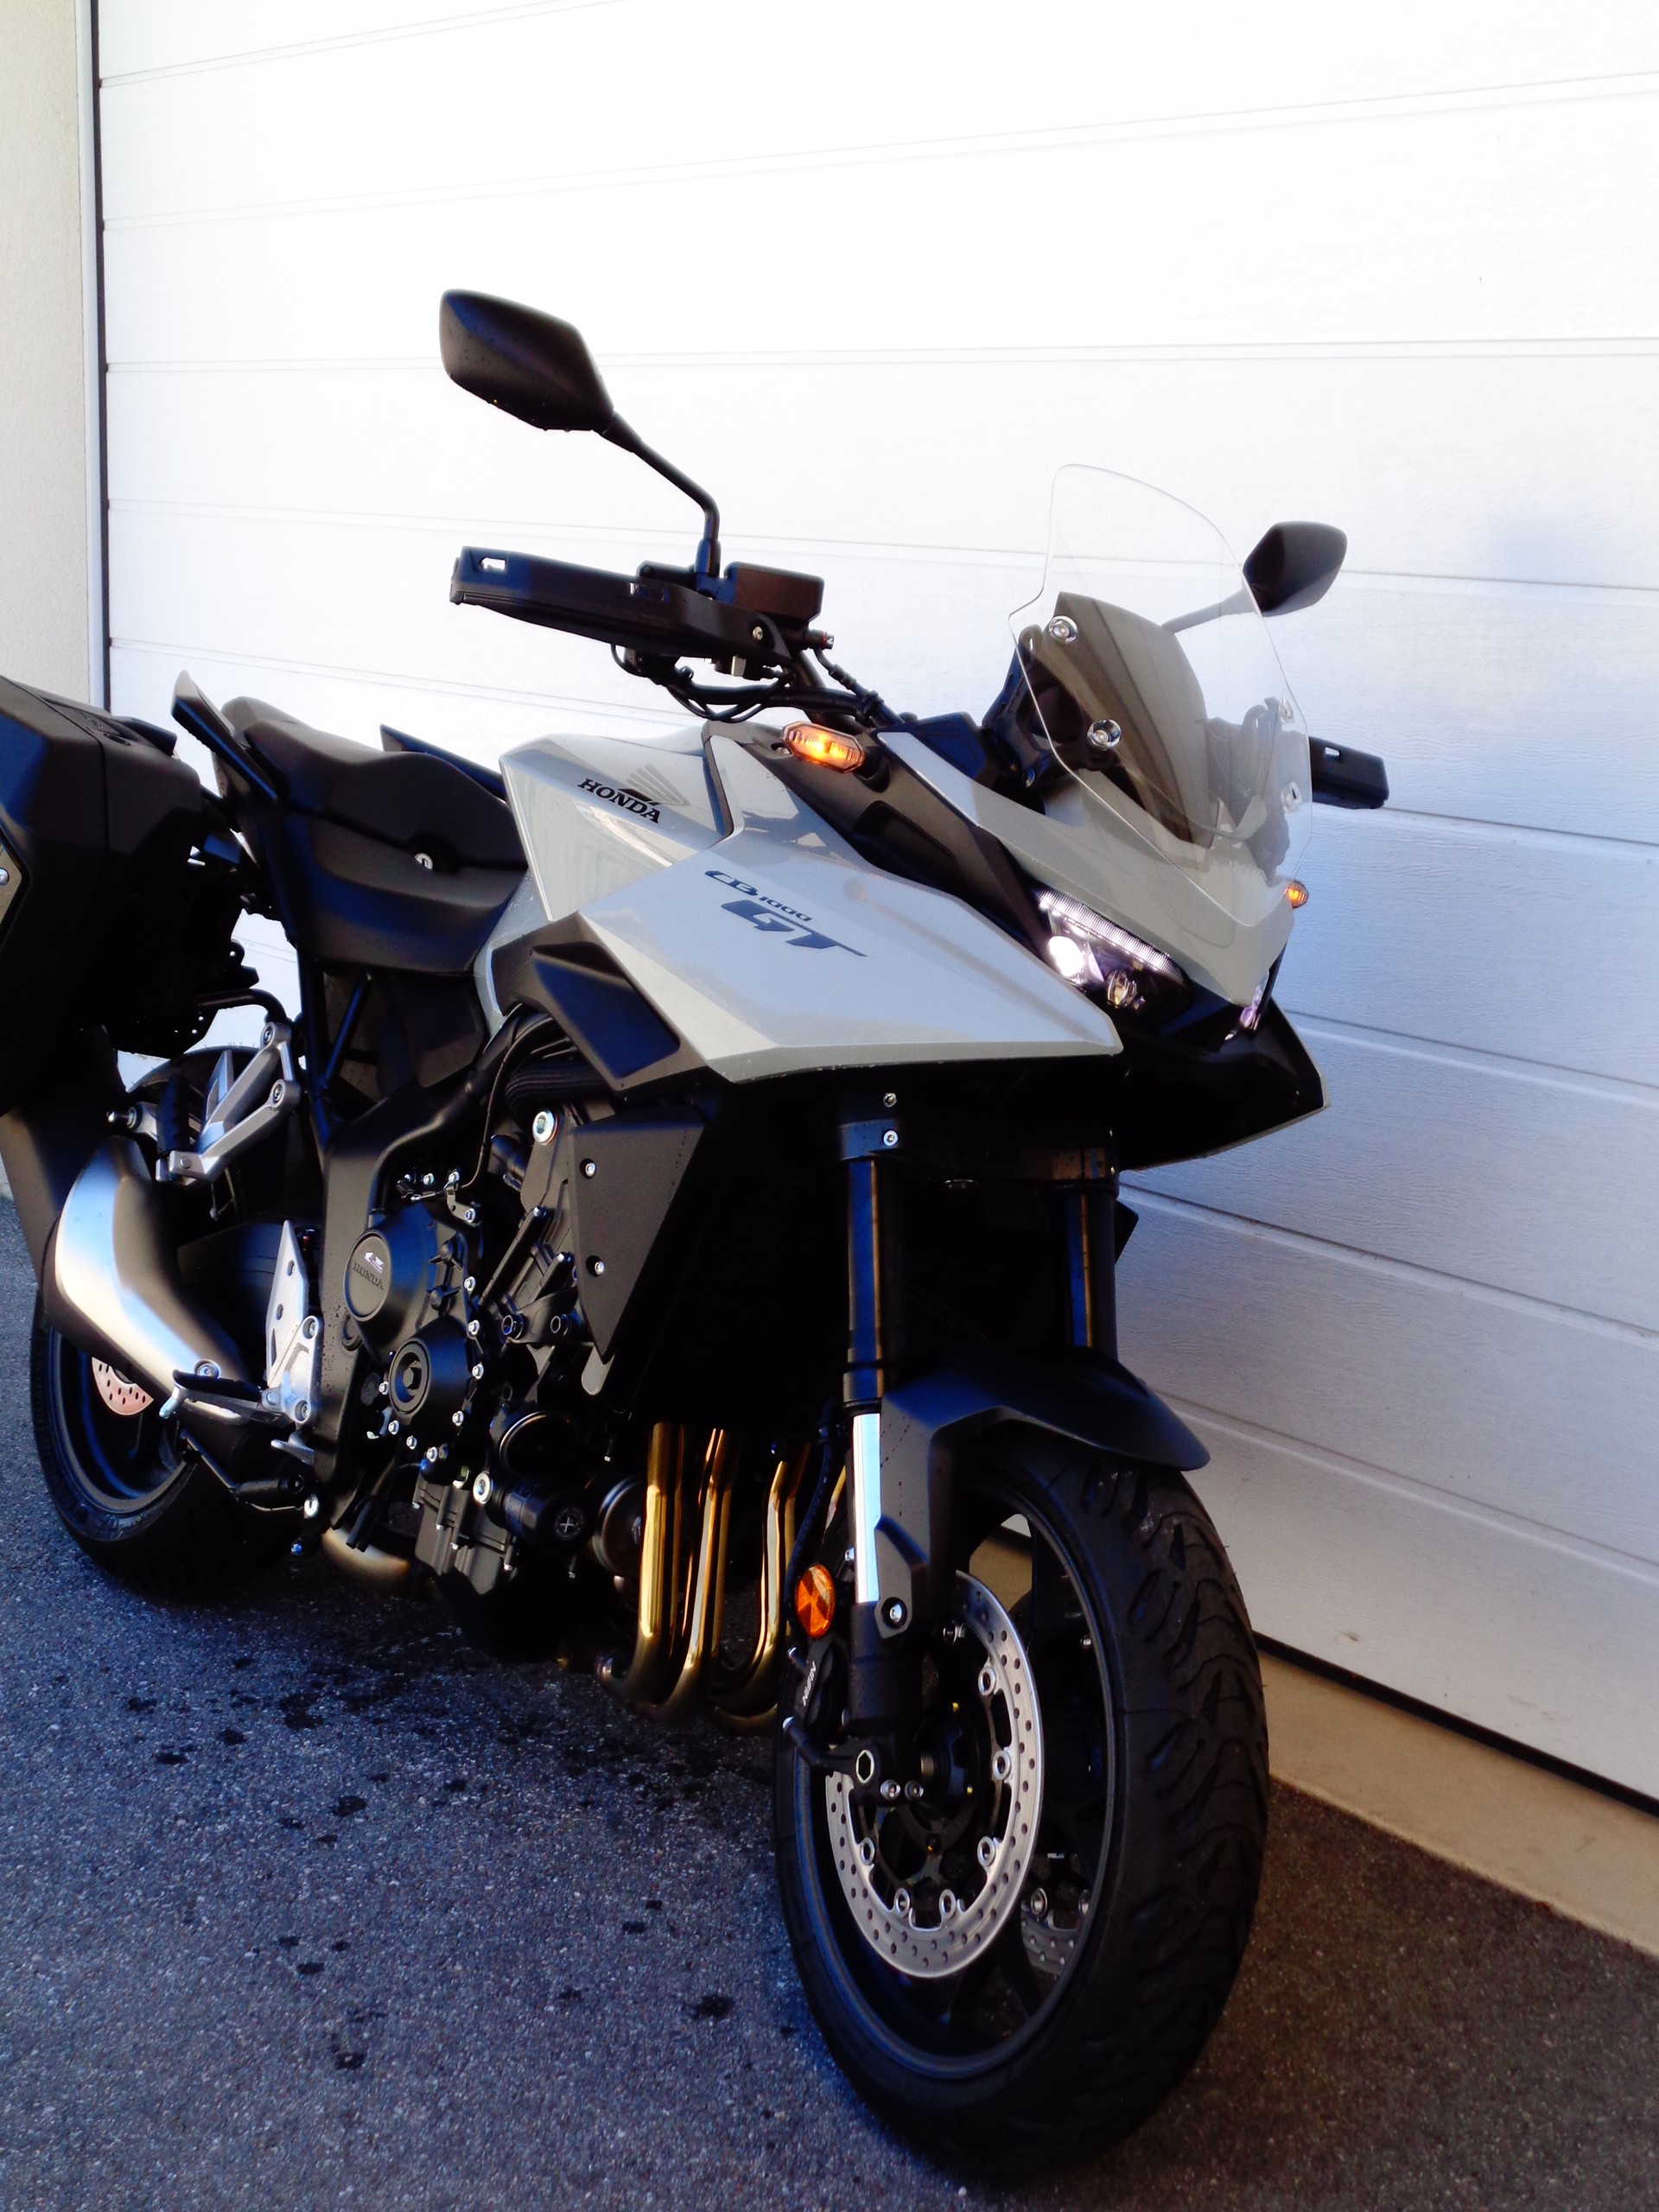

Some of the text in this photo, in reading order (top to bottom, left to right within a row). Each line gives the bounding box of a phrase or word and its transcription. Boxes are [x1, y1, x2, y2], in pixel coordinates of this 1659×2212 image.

[577, 778, 660, 823] HONDA
[721, 899, 869, 957] GT
[353, 1262, 384, 1291] HONDA
